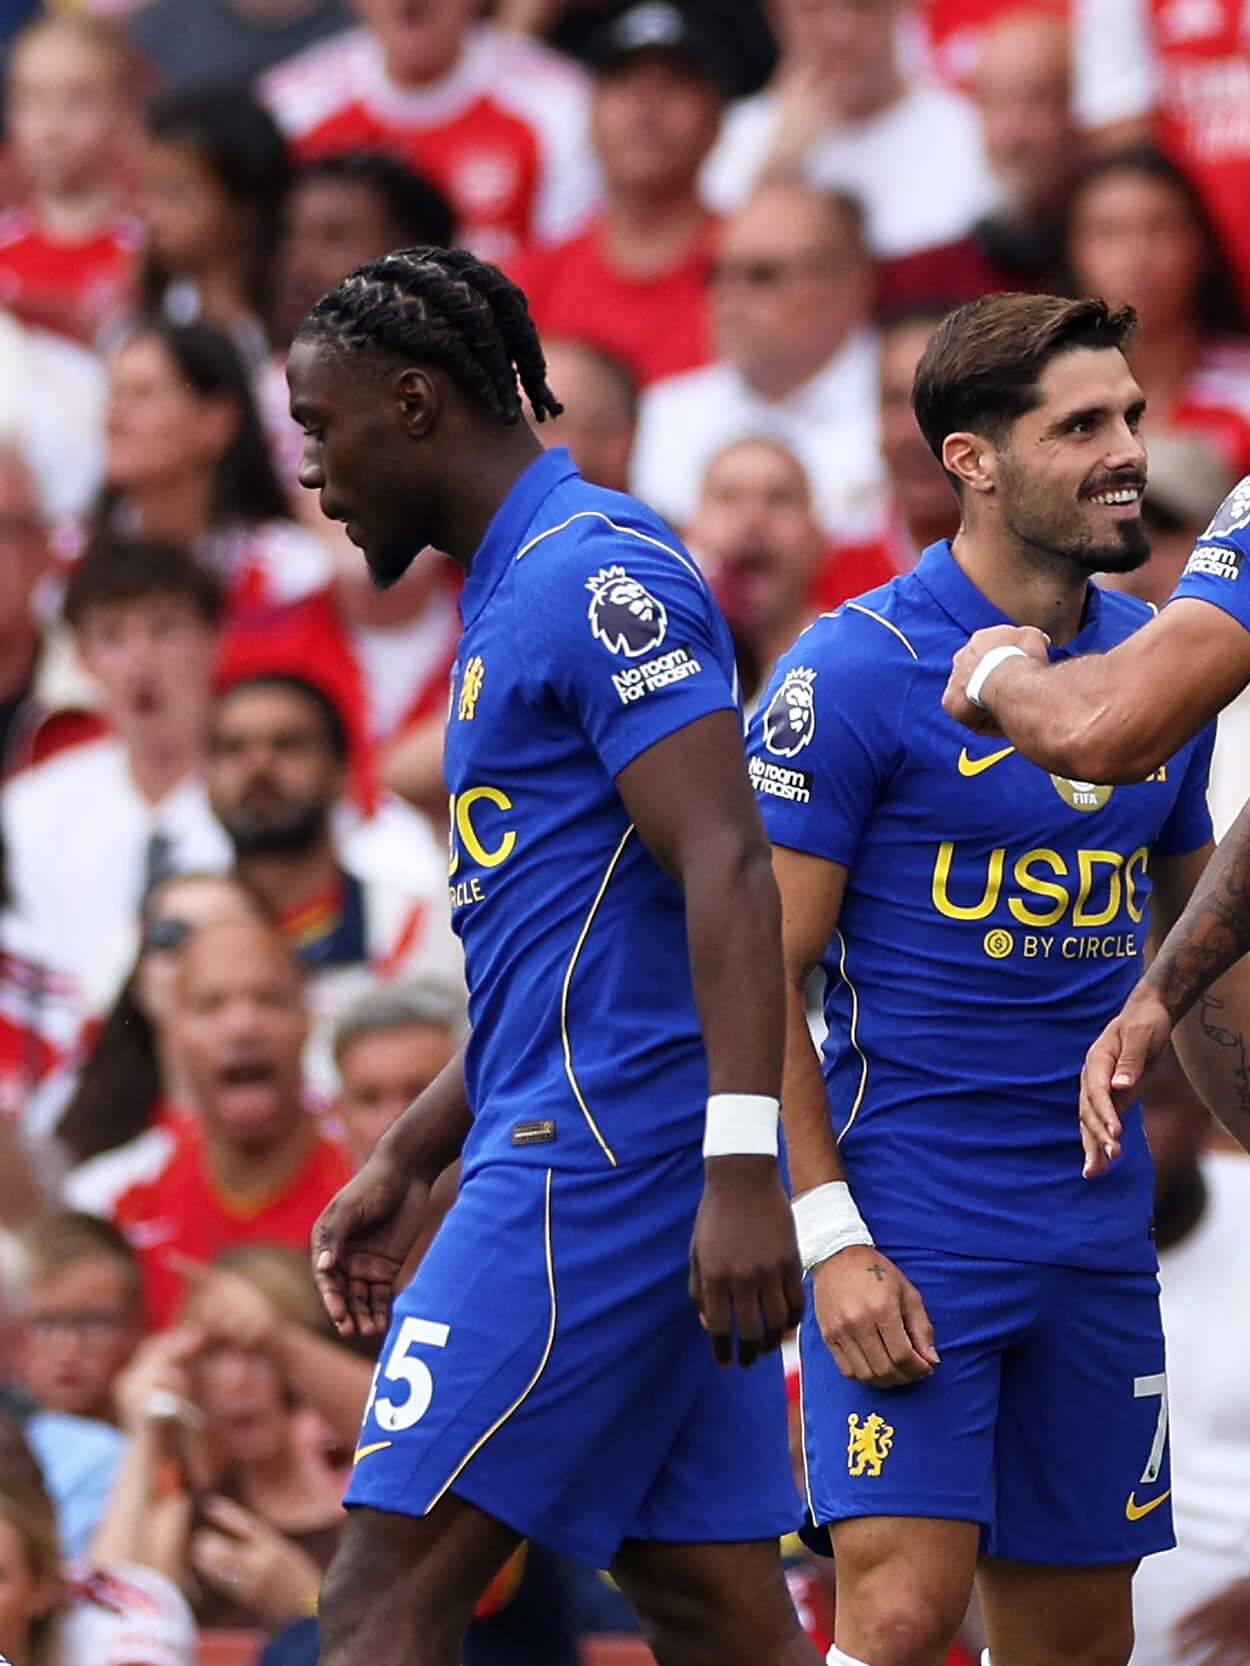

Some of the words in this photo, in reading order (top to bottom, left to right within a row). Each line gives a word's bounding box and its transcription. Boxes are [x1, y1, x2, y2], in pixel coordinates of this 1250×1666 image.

[611, 668, 641, 690] No
[639, 649, 688, 678] room
[645, 660, 702, 691] racism
[764, 763, 805, 788] room
[760, 779, 810, 803] racism
[1073, 791, 1098, 805] FIFA
[1023, 935, 1054, 957] BY
[1061, 934, 1137, 959] CIRCLE
[362, 1316, 451, 1432] 5
[1133, 1372, 1167, 1483] 7
